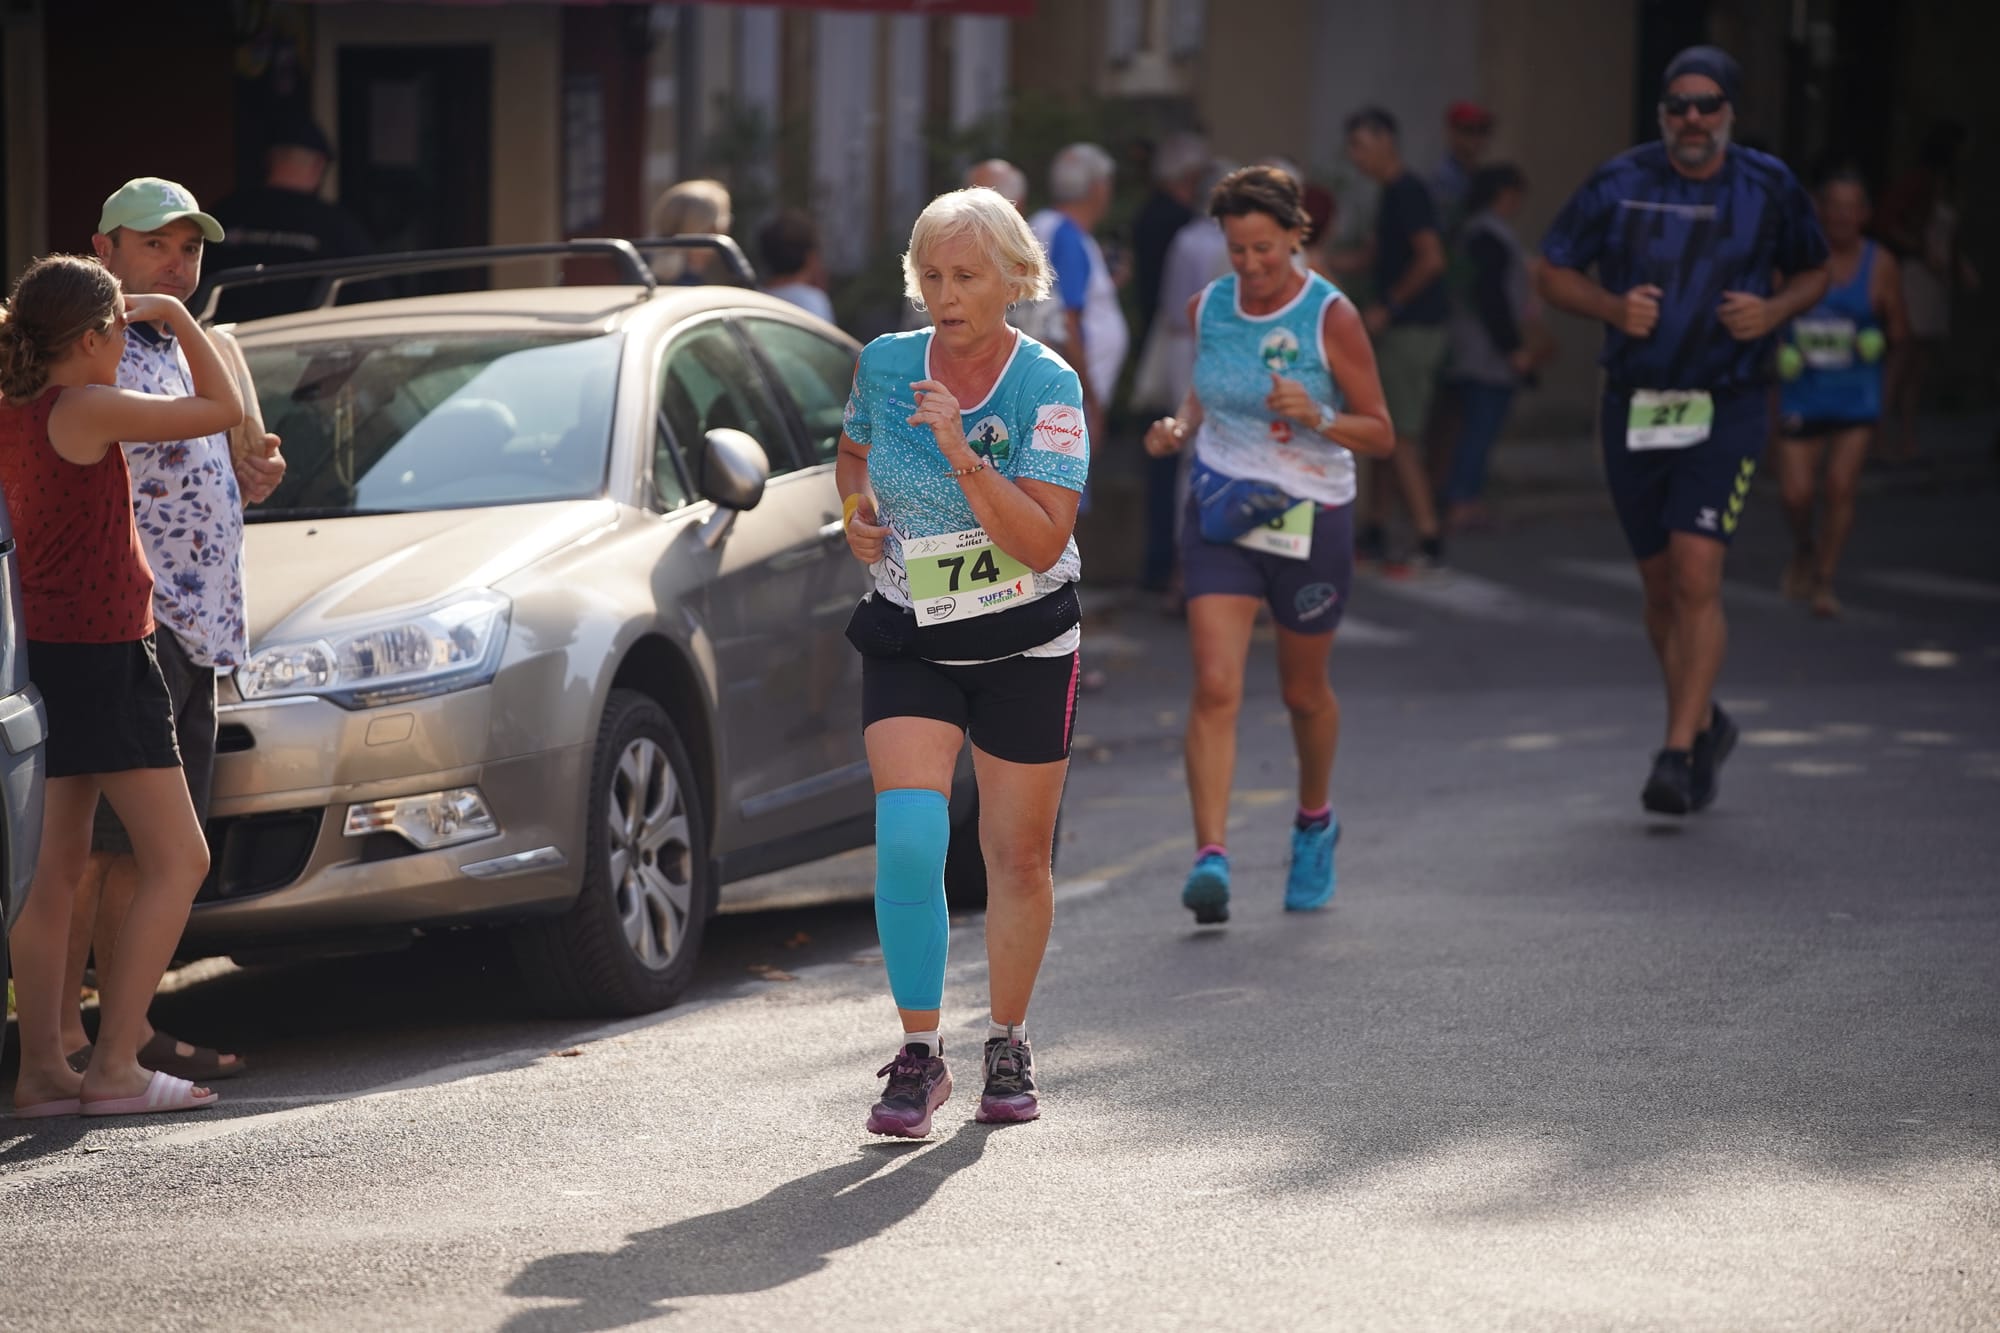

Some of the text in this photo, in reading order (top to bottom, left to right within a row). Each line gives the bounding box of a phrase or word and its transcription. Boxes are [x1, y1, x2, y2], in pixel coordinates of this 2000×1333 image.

[1651, 404, 1689, 426] 27
[959, 530, 987, 541] Challe
[938, 549, 1000, 592] 74
[978, 588, 1013, 603] TUFF'S
[926, 603, 952, 614] BFP
